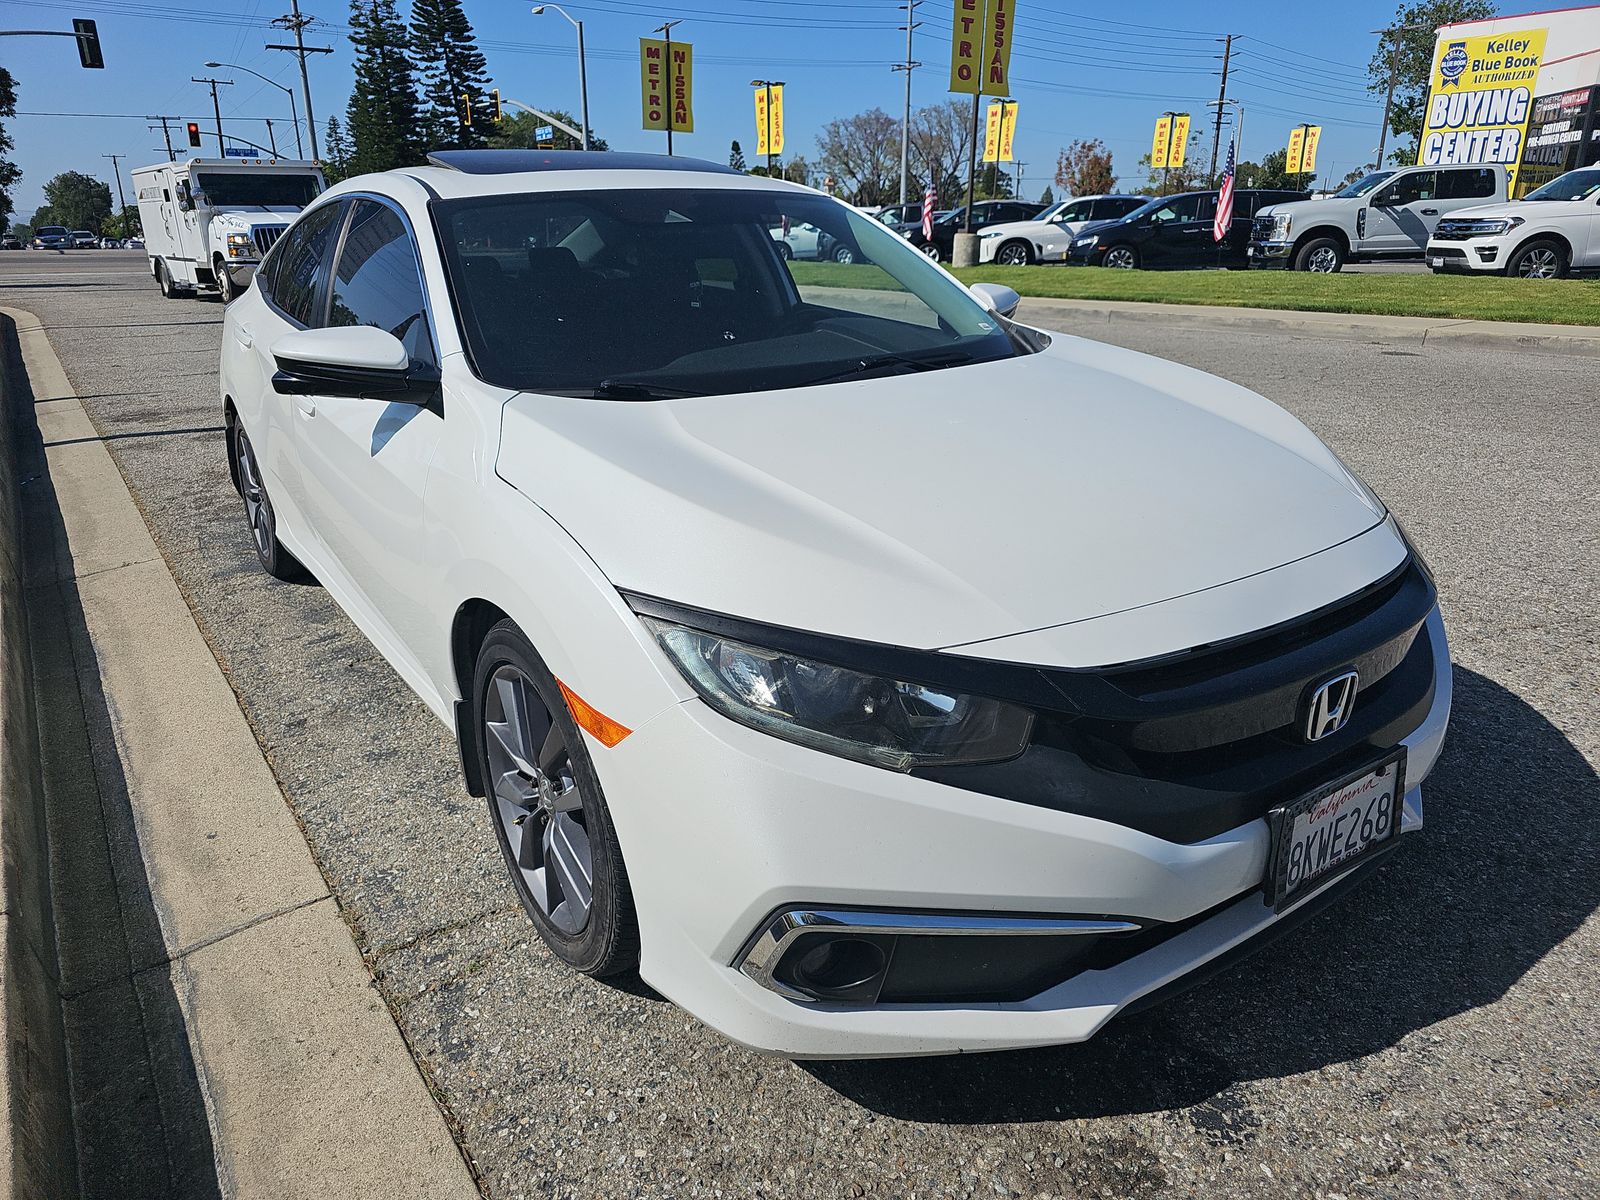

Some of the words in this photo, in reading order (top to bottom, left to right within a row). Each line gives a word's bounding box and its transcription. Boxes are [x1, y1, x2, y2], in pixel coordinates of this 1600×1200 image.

[958, 0, 976, 81] ETRO
[990, 0, 1005, 84] ISSAN
[1487, 39, 1530, 54] Kelley
[1471, 59, 1501, 72] Blue
[1504, 55, 1539, 69] Book
[1471, 69, 1535, 84] AUTHORIZED
[646, 47, 661, 122] METRO
[673, 50, 687, 124] NISSAN
[773, 93, 781, 147] NISSAN
[1428, 86, 1531, 129] BUYING
[1541, 120, 1571, 135] CERTIFIED
[1543, 103, 1561, 111] NISSAN
[1156, 122, 1167, 163] METRO
[1173, 121, 1185, 163] NISSAN
[1289, 133, 1301, 169] METRO
[1305, 131, 1317, 168] NISSAN
[1423, 128, 1522, 165] CENTER
[1526, 133, 1559, 148] PRE-OWNED
[1559, 130, 1583, 144] CENTER
[1307, 777, 1379, 825] California
[1286, 792, 1391, 887] 8KWE268
